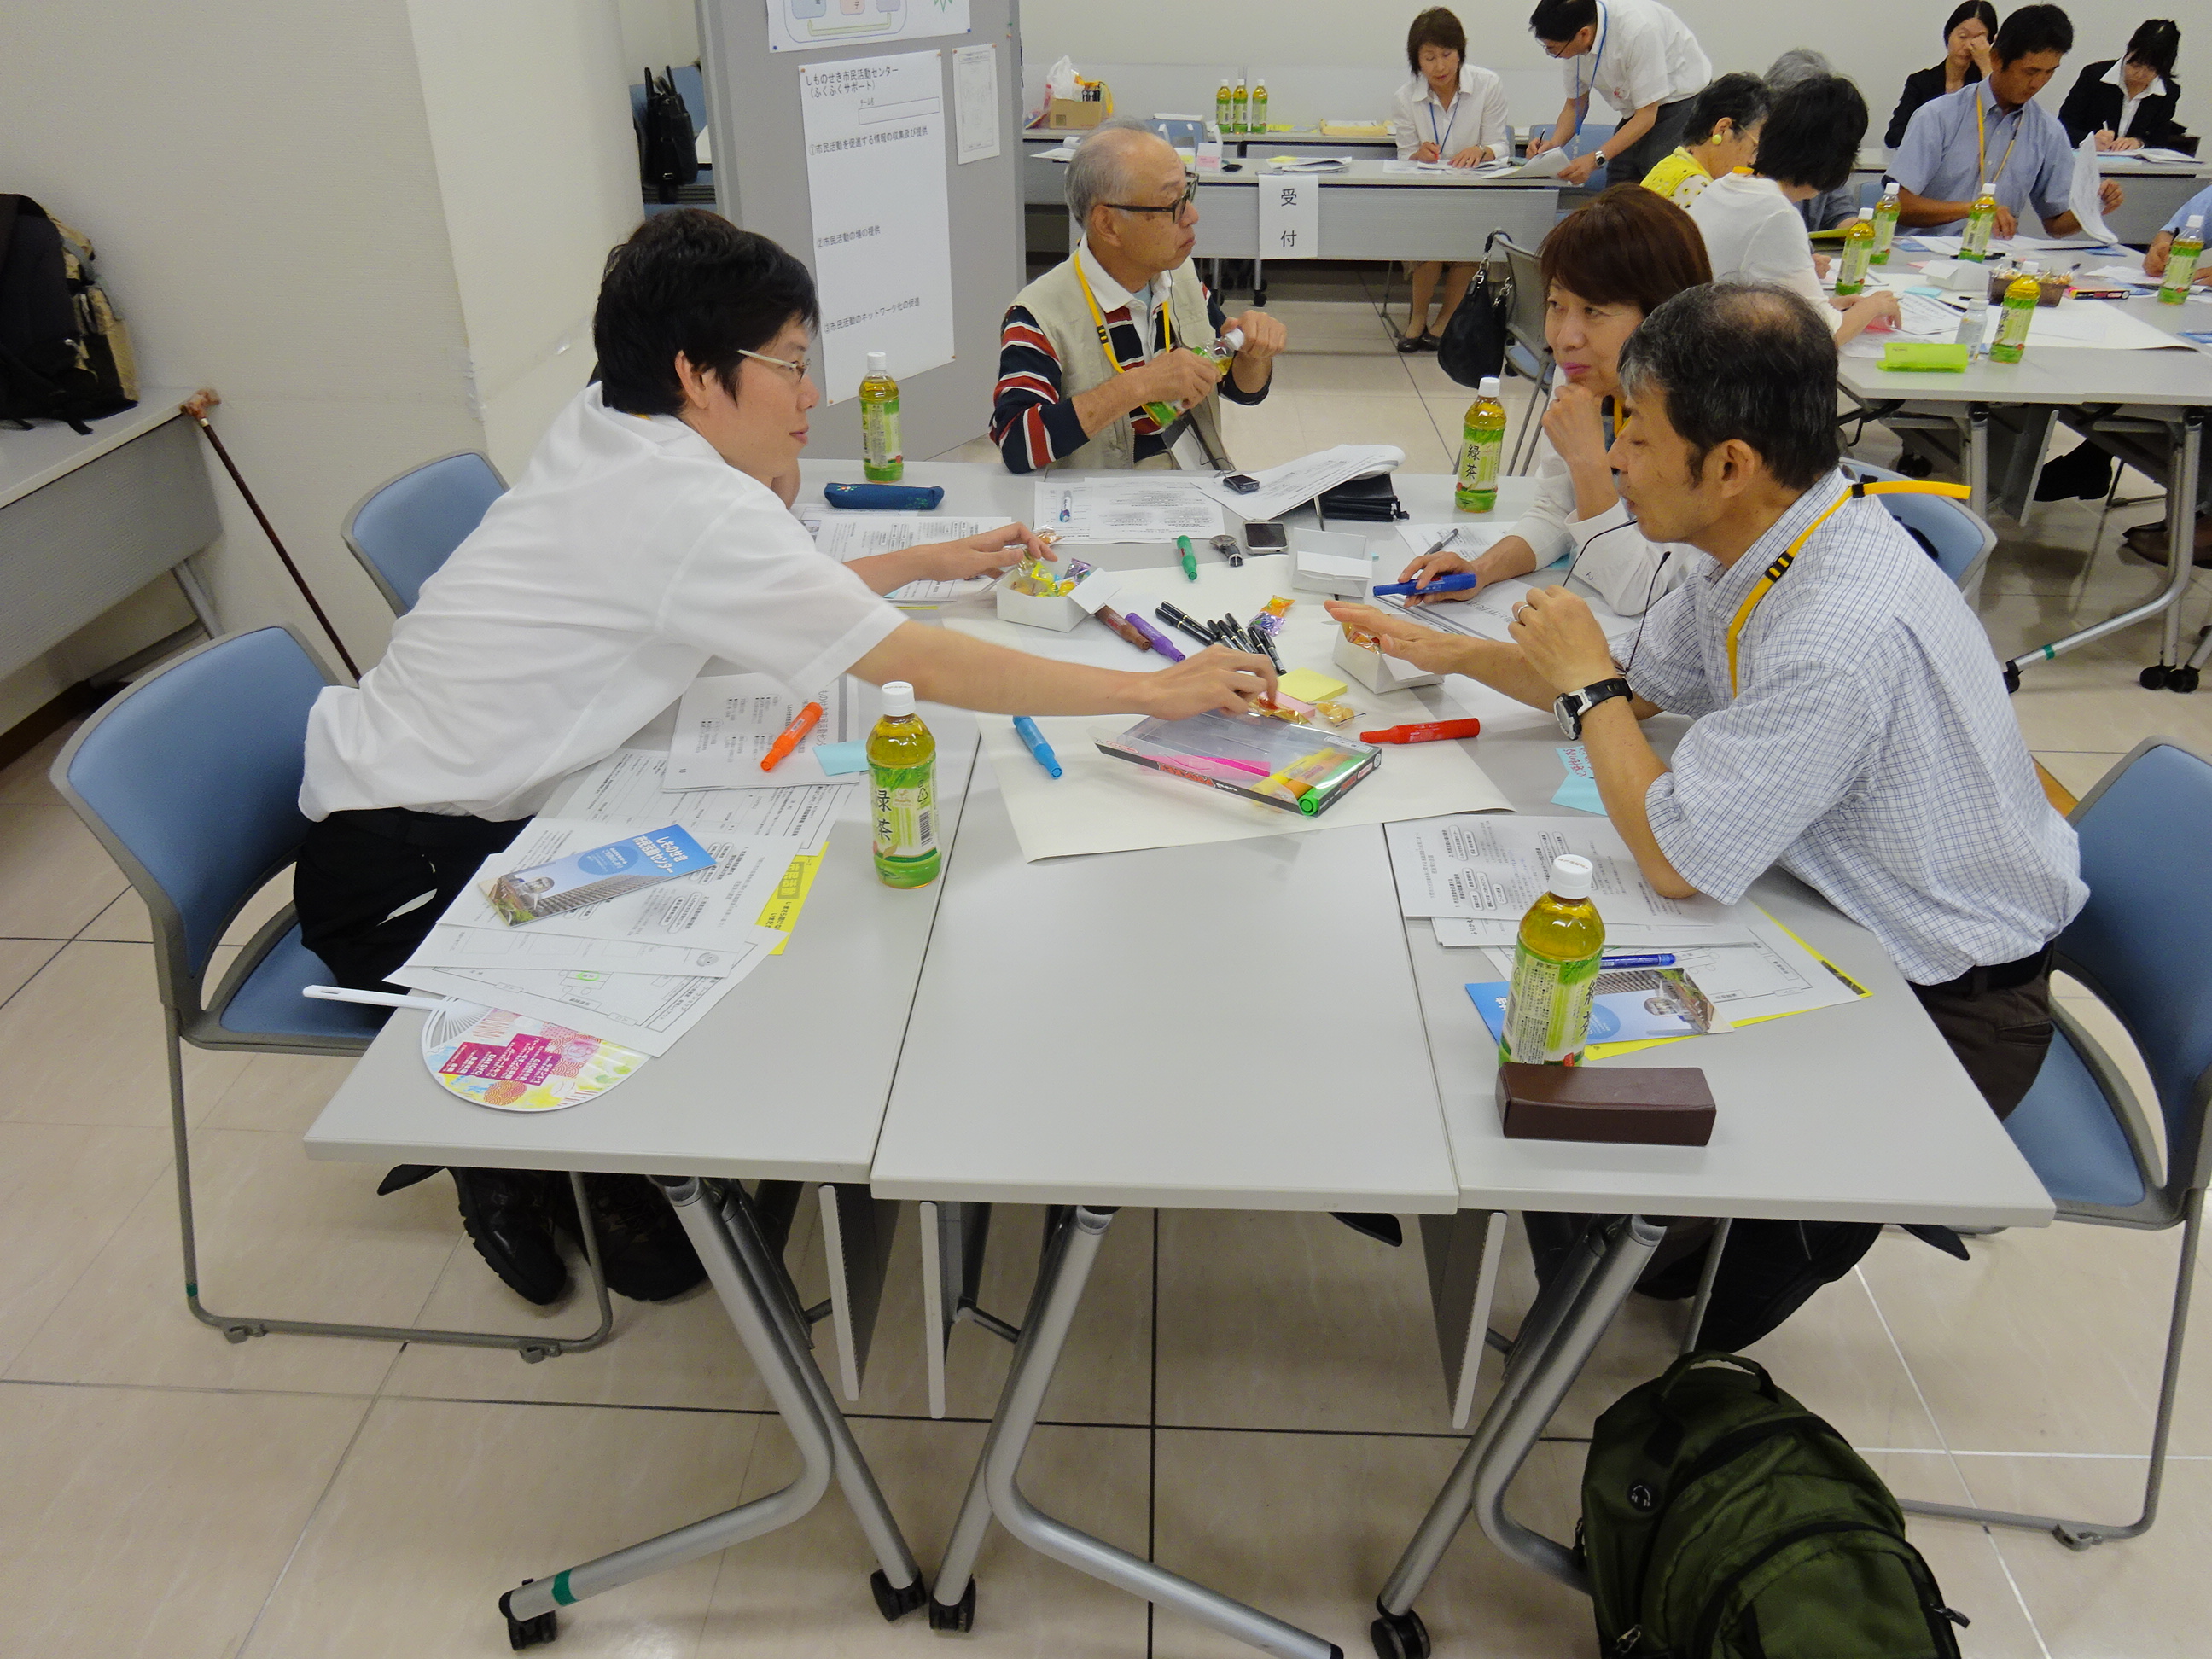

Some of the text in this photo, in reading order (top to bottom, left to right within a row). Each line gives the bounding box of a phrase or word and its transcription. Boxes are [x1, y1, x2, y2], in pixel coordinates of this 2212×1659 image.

[806, 67, 899, 86] しものせき市民活動センター
[1465, 443, 1481, 480] 緑茶
[632, 835, 673, 874] 市民活動センター
[655, 835, 689, 863] しものせき
[475, 1054, 497, 1075] DAISYO
